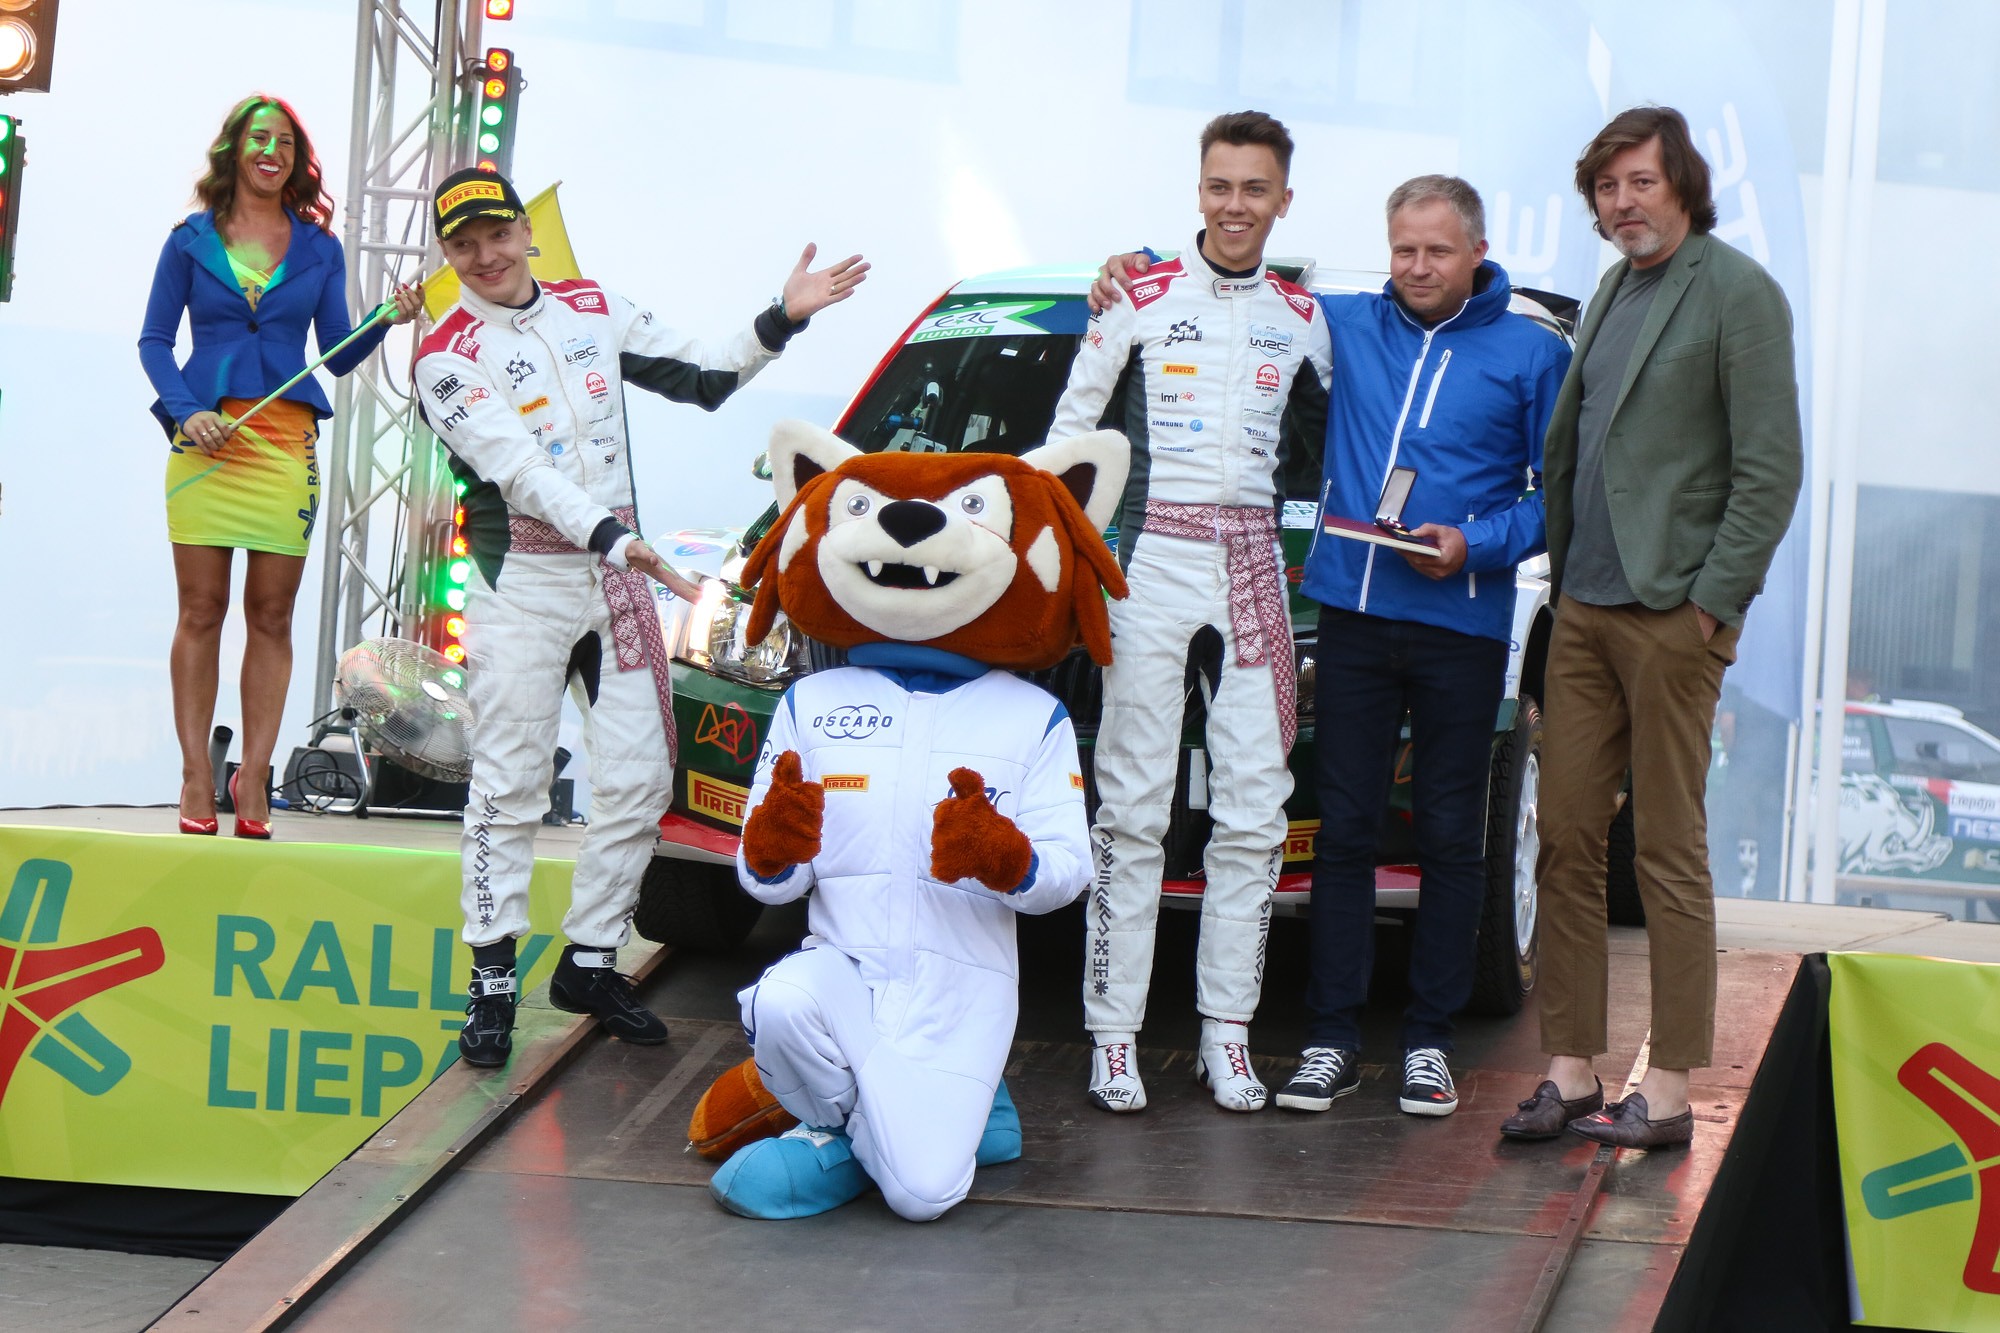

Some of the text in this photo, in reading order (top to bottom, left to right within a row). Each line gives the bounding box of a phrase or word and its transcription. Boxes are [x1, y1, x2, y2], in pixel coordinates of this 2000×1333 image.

[441, 184, 498, 211] PIRELLI
[1134, 285, 1161, 298] OMP
[575, 296, 600, 307] OMP
[918, 326, 989, 341] JUNIOR
[1250, 336, 1289, 353] WRC
[564, 345, 598, 363] WRC
[434, 377, 459, 400] OMP
[1161, 392, 1178, 403] lmt
[441, 404, 469, 432] lmt
[1151, 420, 1184, 428] SAMSUNG
[303, 429, 317, 486] RALLY
[812, 715, 893, 728] OSCARO
[823, 776, 865, 789] PIRELLI
[693, 779, 749, 820] PIREL
[602, 956, 615, 964] OM
[489, 982, 510, 991] OMP
